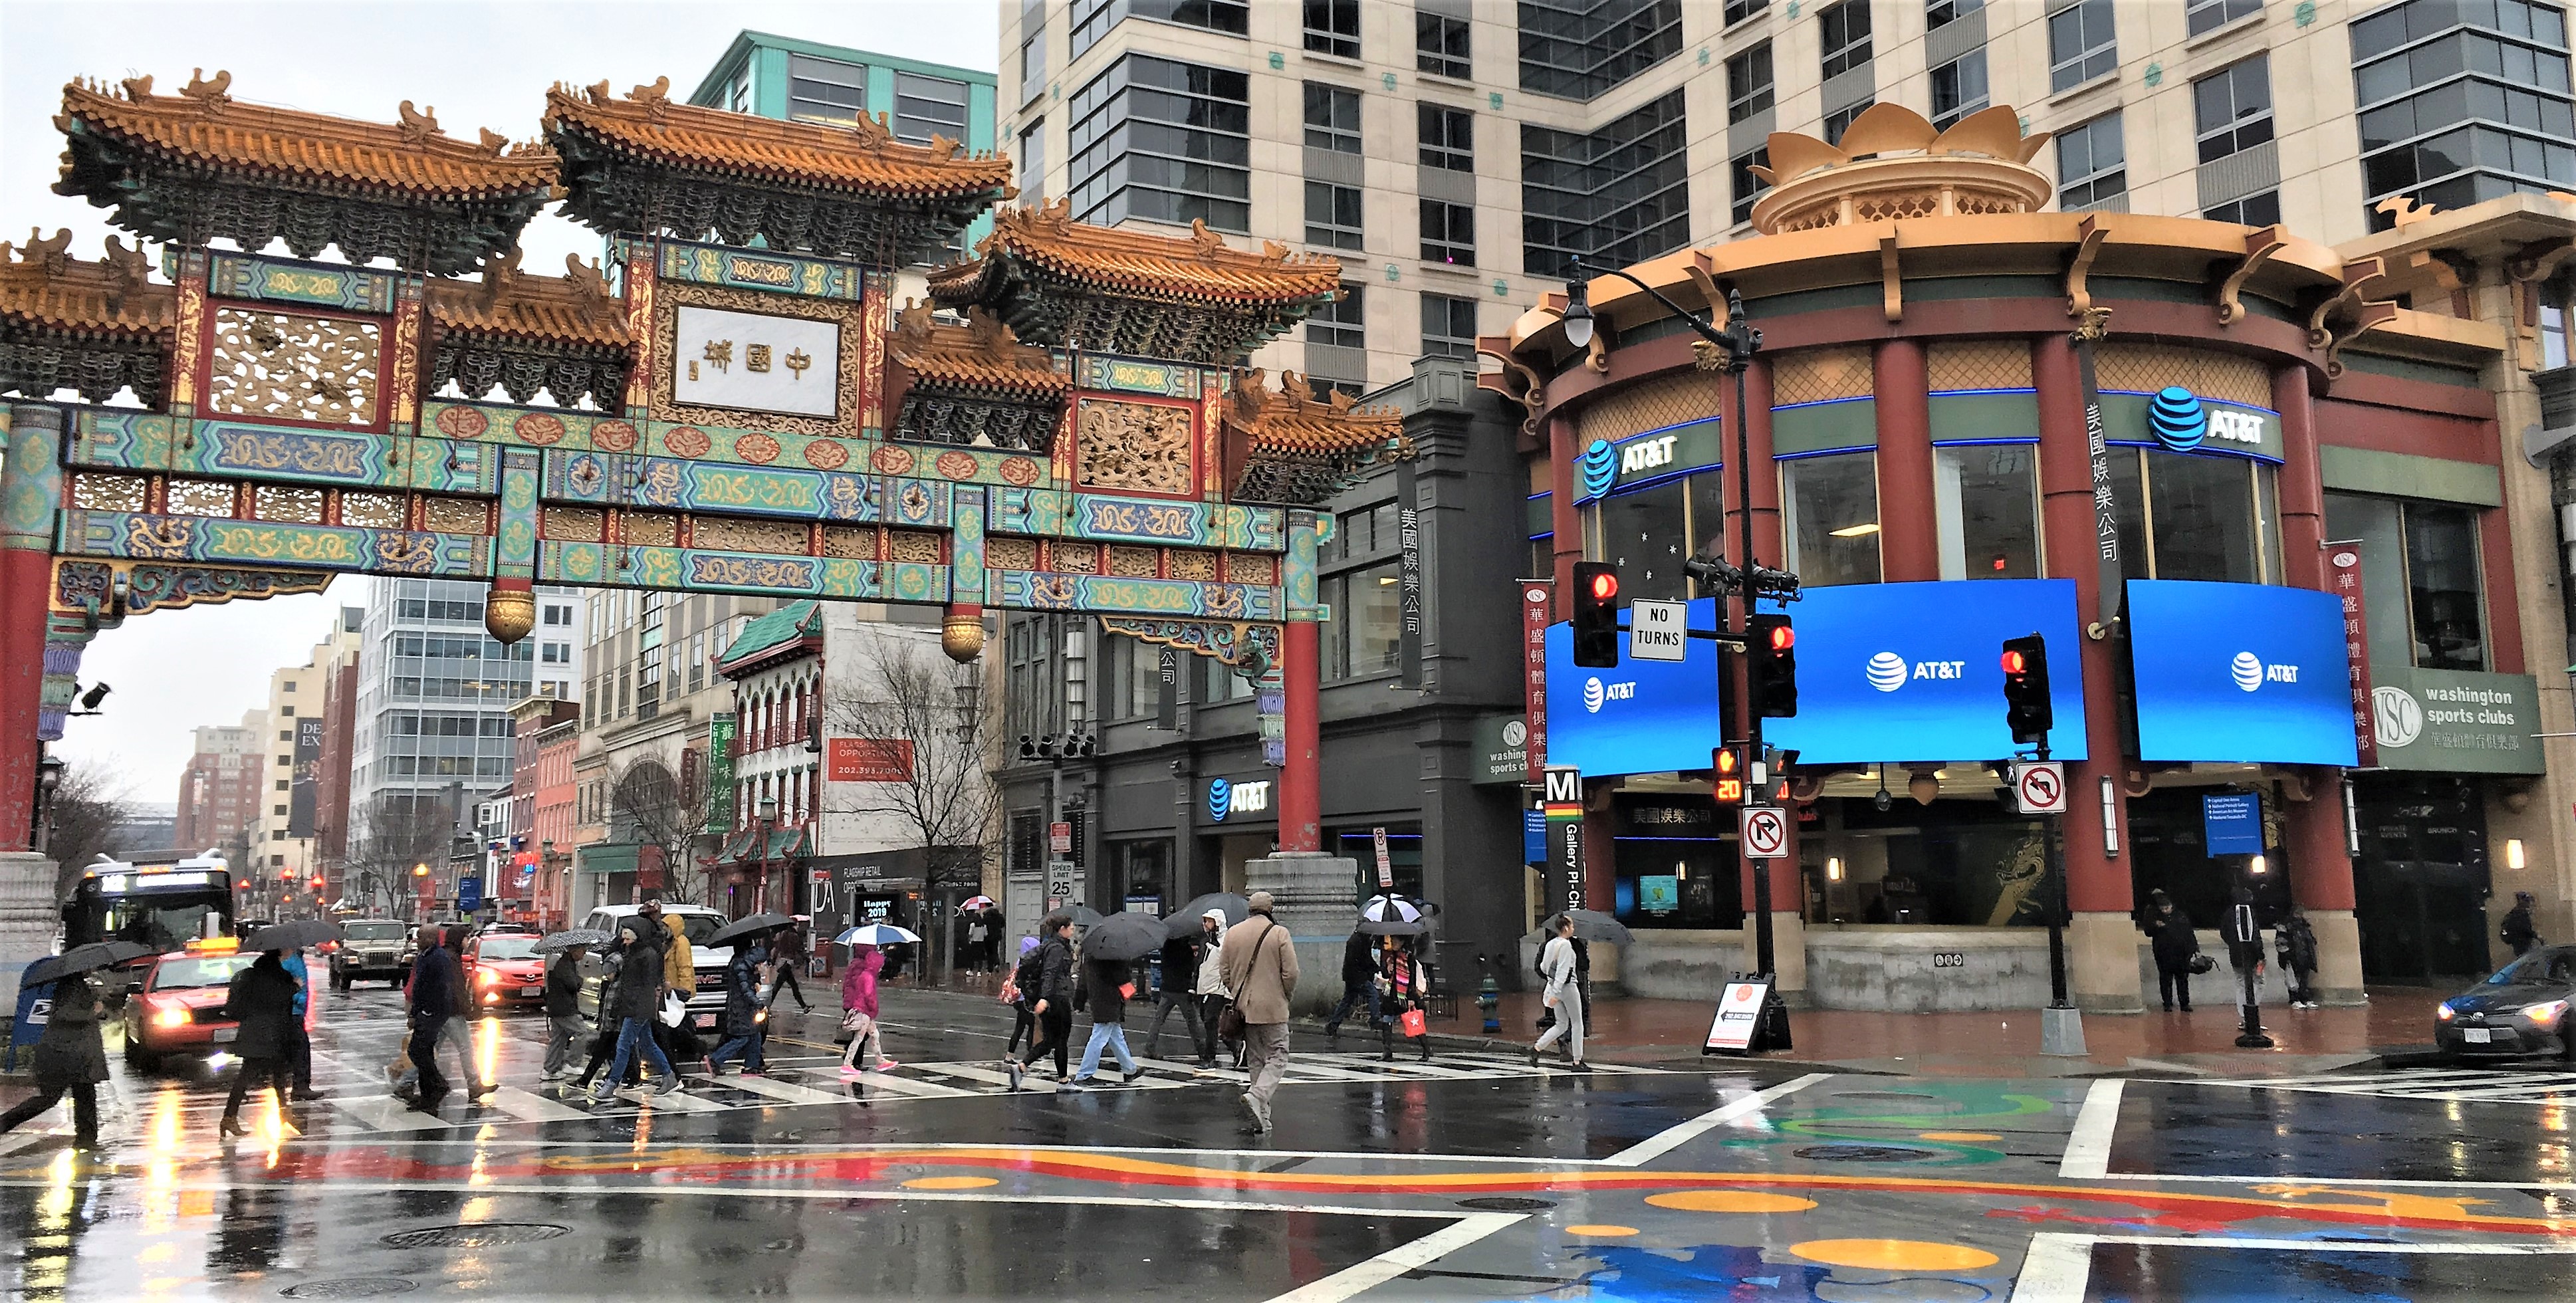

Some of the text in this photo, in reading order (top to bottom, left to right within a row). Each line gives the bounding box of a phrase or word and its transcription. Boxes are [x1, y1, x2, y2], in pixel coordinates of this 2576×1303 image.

[2208, 409, 2264, 444] AT&T
[1621, 435, 1677, 475] AT&T
[2086, 402, 2117, 562] 美國娛樂公司
[1401, 508, 1421, 635] 美國娛樂公司
[1650, 608, 1668, 622] NO
[1637, 630, 1679, 646] TURNS
[1160, 645, 1175, 685] 公司
[1913, 661, 1965, 679] AT&T
[2266, 664, 2299, 683] AT&T
[1605, 681, 1635, 700] AT&T
[2426, 687, 2513, 706] washington
[2427, 708, 2516, 725] sports clubs
[1490, 749, 1528, 761] washing
[1490, 762, 1518, 775] sports
[1546, 772, 1576, 801] M
[1718, 780, 1740, 798] 20
[1230, 781, 1268, 812] AT&T
[1566, 824, 1578, 868] Gallery
[1052, 881, 1070, 895] 25
[868, 907, 887, 917] 2019
[695, 975, 723, 984] MC
